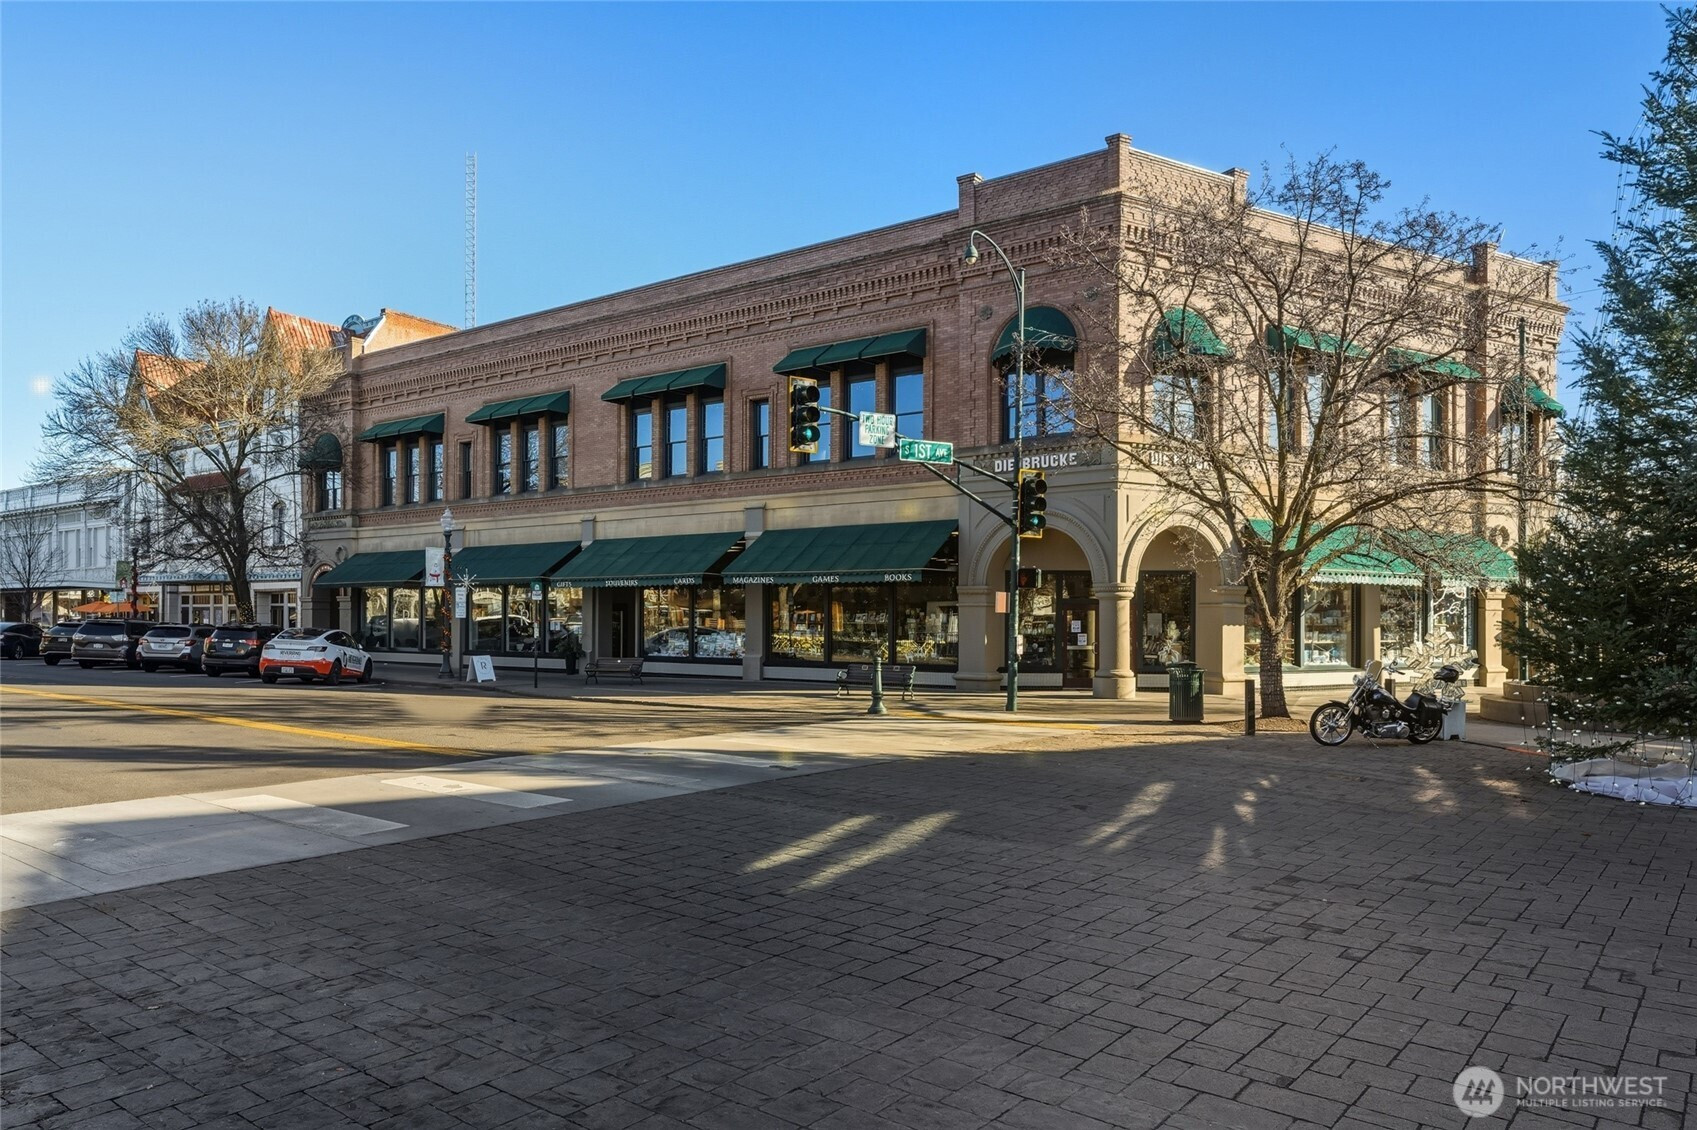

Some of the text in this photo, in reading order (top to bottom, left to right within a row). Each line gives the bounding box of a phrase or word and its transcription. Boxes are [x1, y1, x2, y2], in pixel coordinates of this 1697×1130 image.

[862, 413, 875, 425] TWO
[864, 424, 890, 435] PARKING
[869, 435, 885, 445] ZONE
[904, 445, 910, 455] S
[914, 444, 932, 459] 1ST
[994, 459, 1015, 473] DIE
[673, 577, 696, 585] CARDS
[732, 573, 912, 584] MAGAZINES GAMES BOOKS
